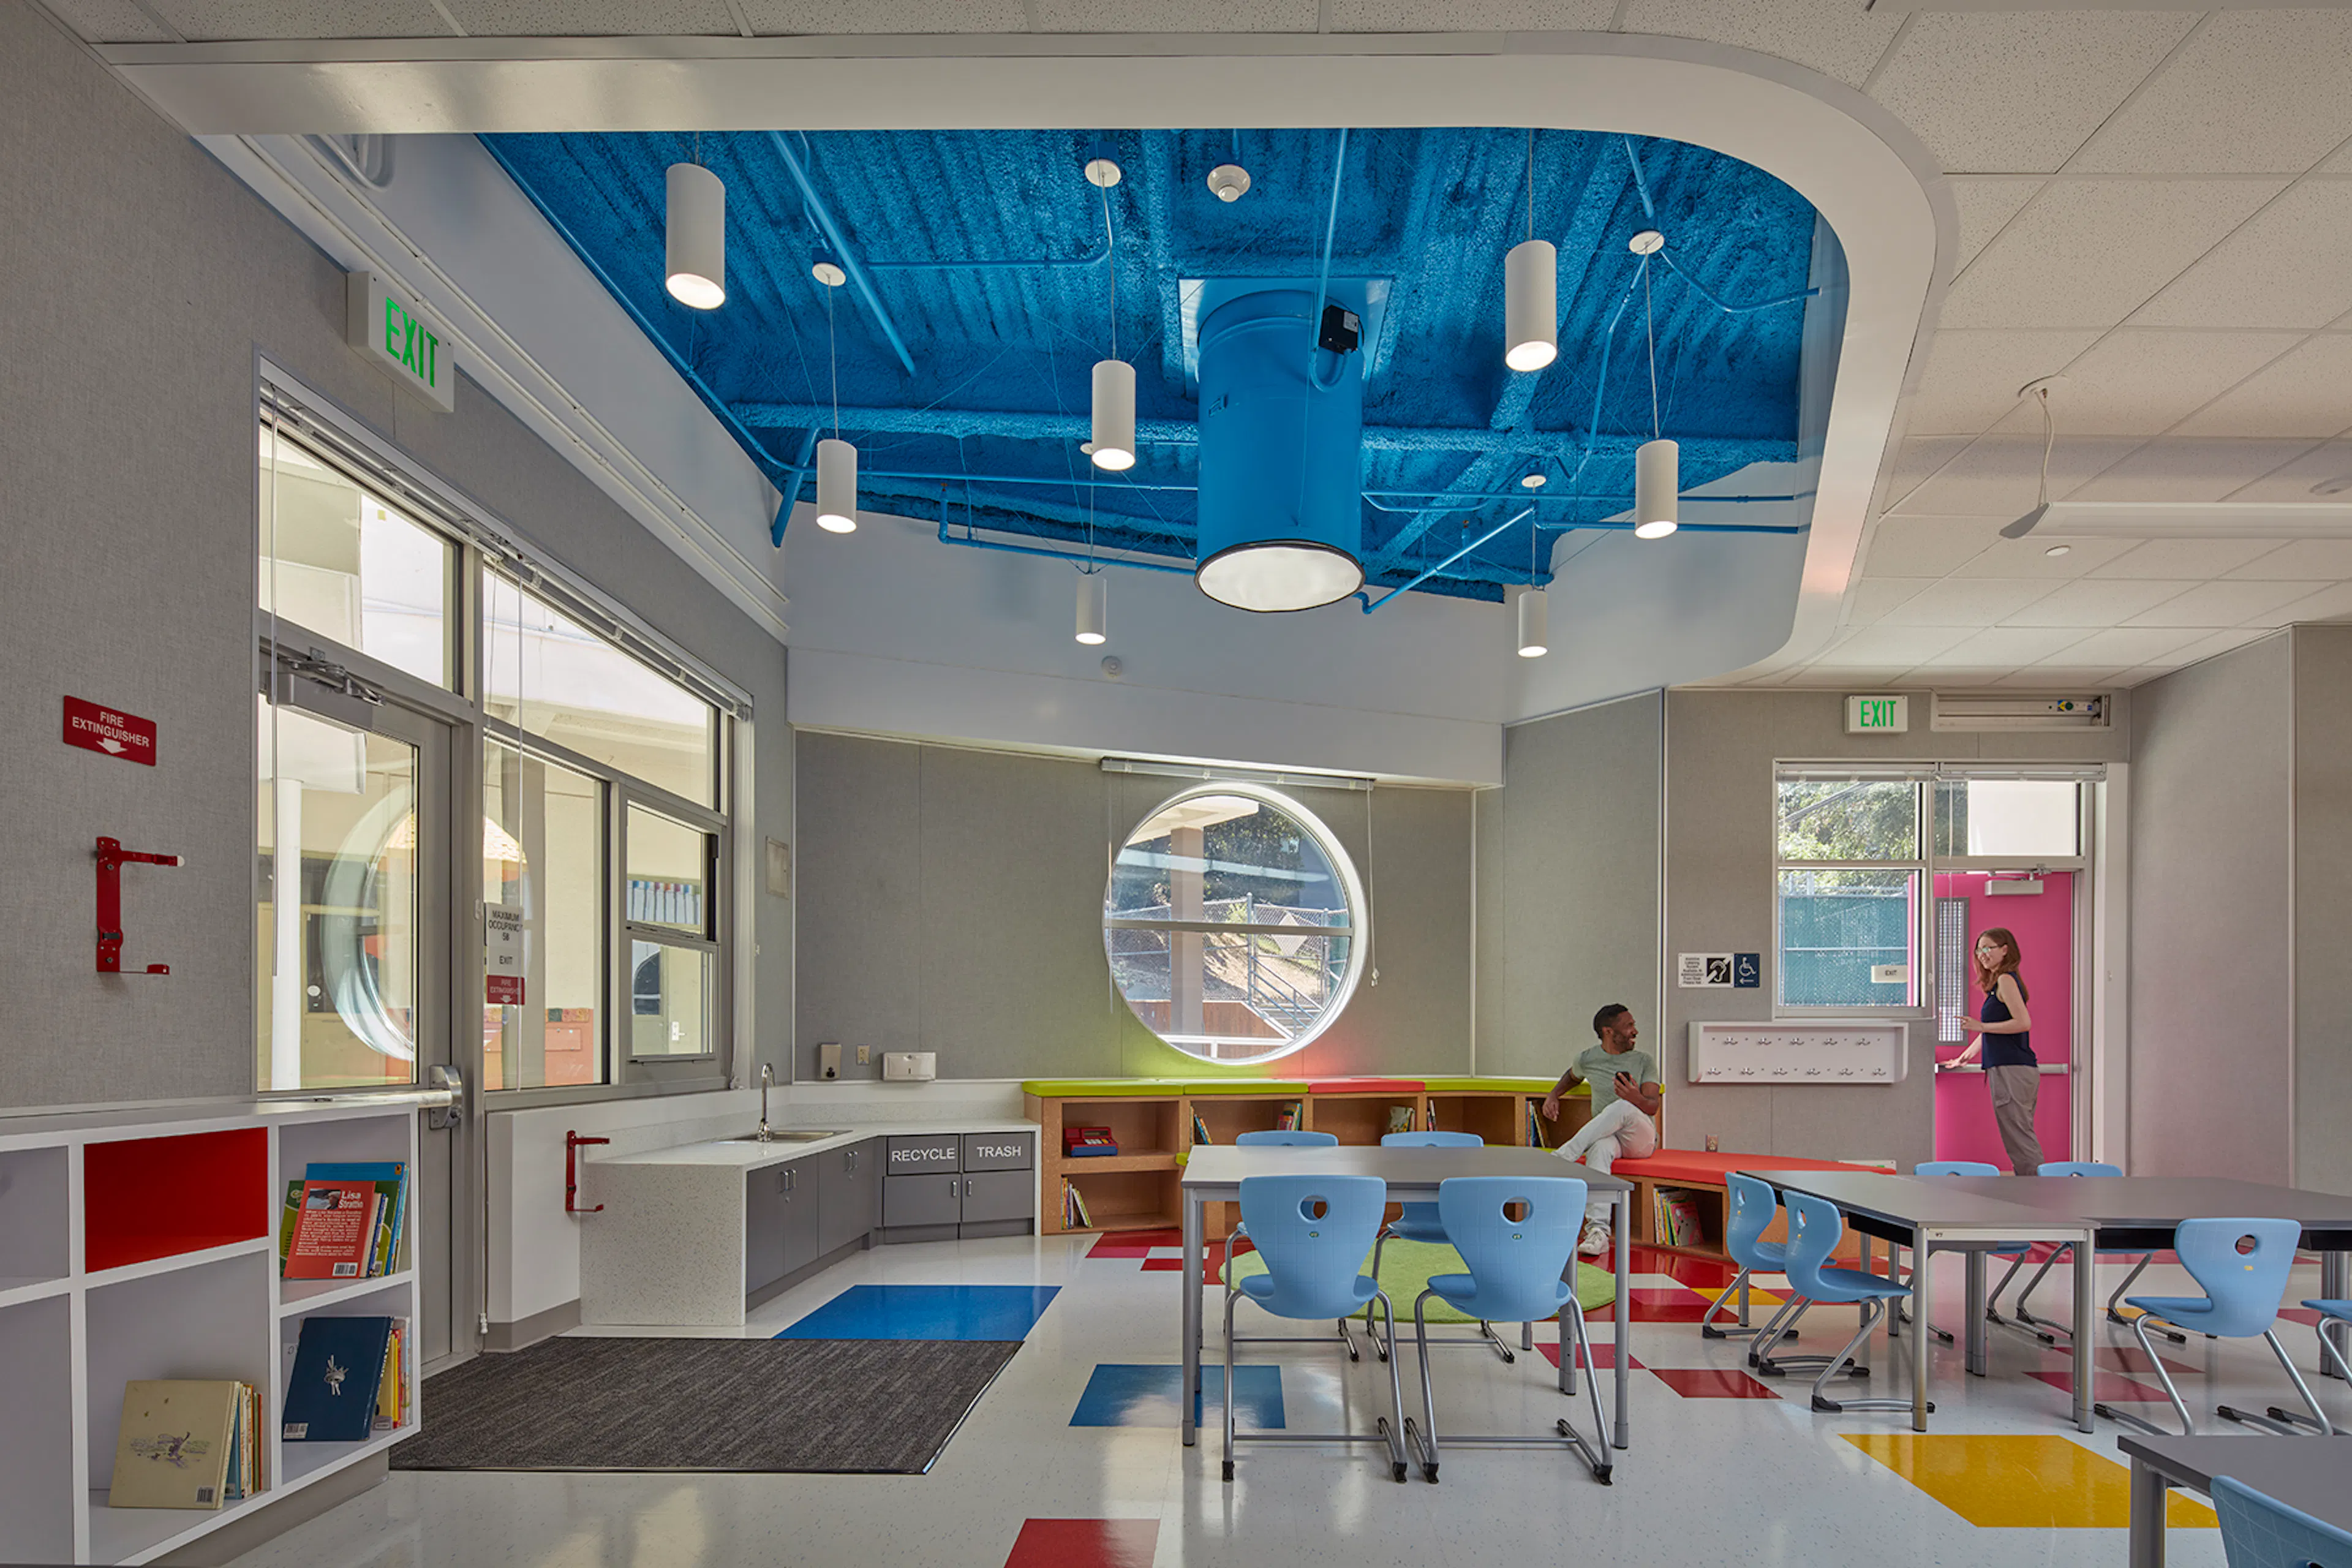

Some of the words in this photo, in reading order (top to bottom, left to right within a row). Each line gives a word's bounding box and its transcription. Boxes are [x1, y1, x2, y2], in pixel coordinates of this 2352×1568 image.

[385, 296, 439, 388] EXIT
[100, 711, 124, 728] FIRE
[1860, 700, 1896, 727] EXIT
[72, 715, 149, 748] EXTINGUISHER
[492, 910, 519, 921] MAXIMUM
[499, 955, 513, 965] EXIT
[892, 1147, 956, 1162] RECYCLE
[976, 1145, 1022, 1158] TRASH
[341, 1190, 361, 1199] Lisa
